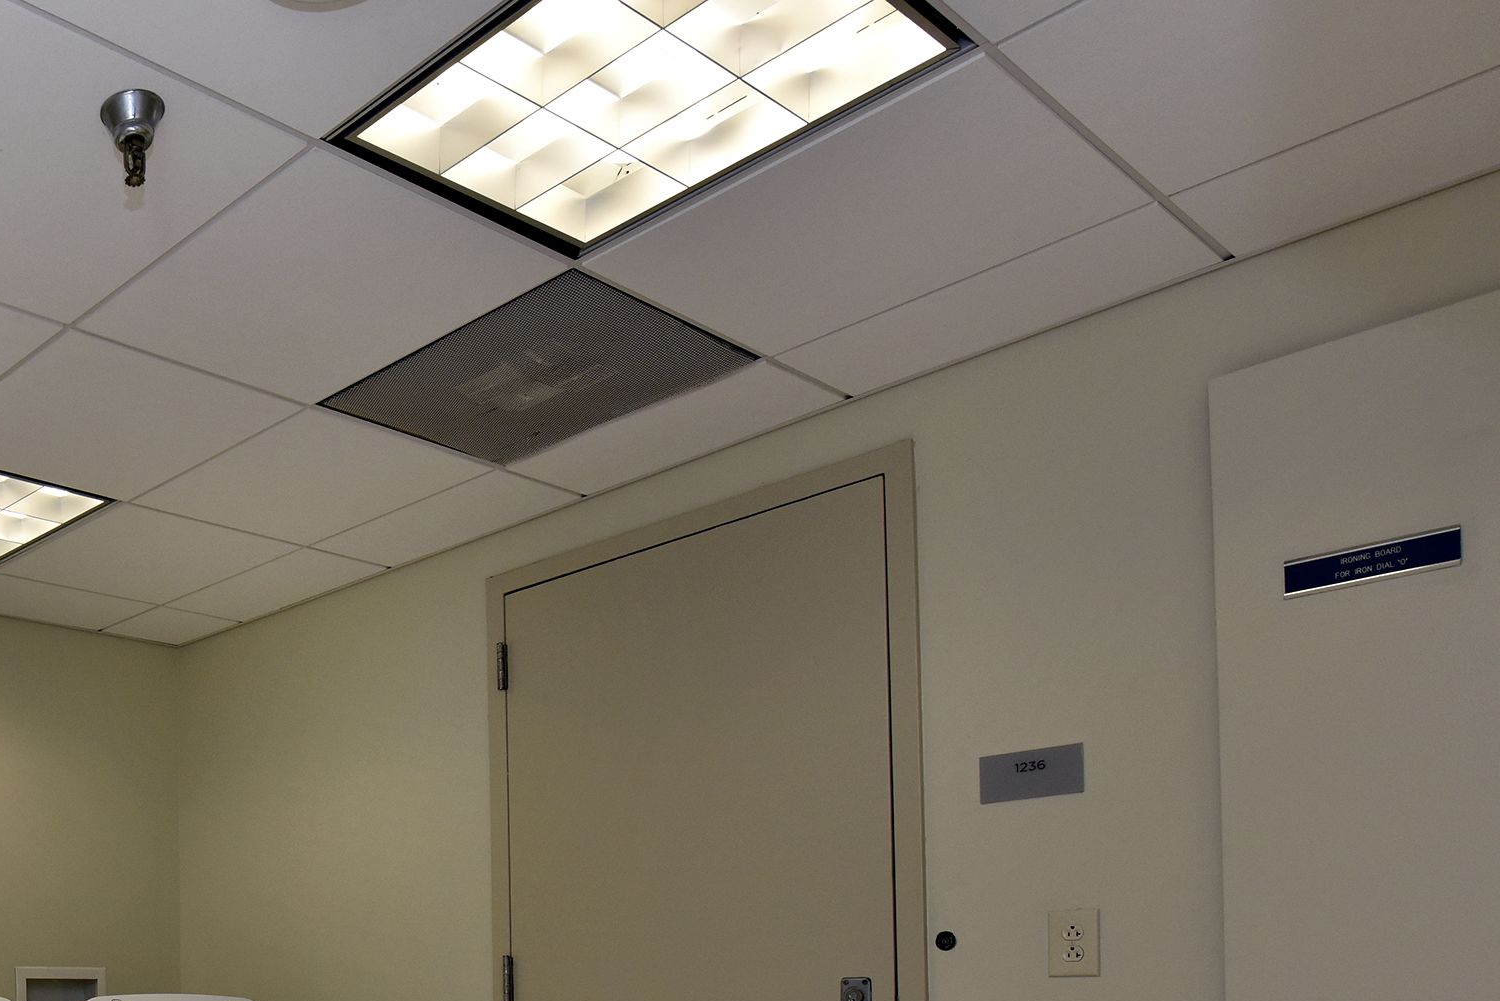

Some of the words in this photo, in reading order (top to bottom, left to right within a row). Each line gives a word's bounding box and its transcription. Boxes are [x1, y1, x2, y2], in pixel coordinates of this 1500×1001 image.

[1340, 552, 1371, 565] IRONING
[1374, 546, 1402, 558] BOARD
[1334, 570, 1350, 579] FOR
[1354, 565, 1373, 575] IRON
[1376, 562, 1395, 571] DIAL
[1014, 759, 1046, 773] 1236
